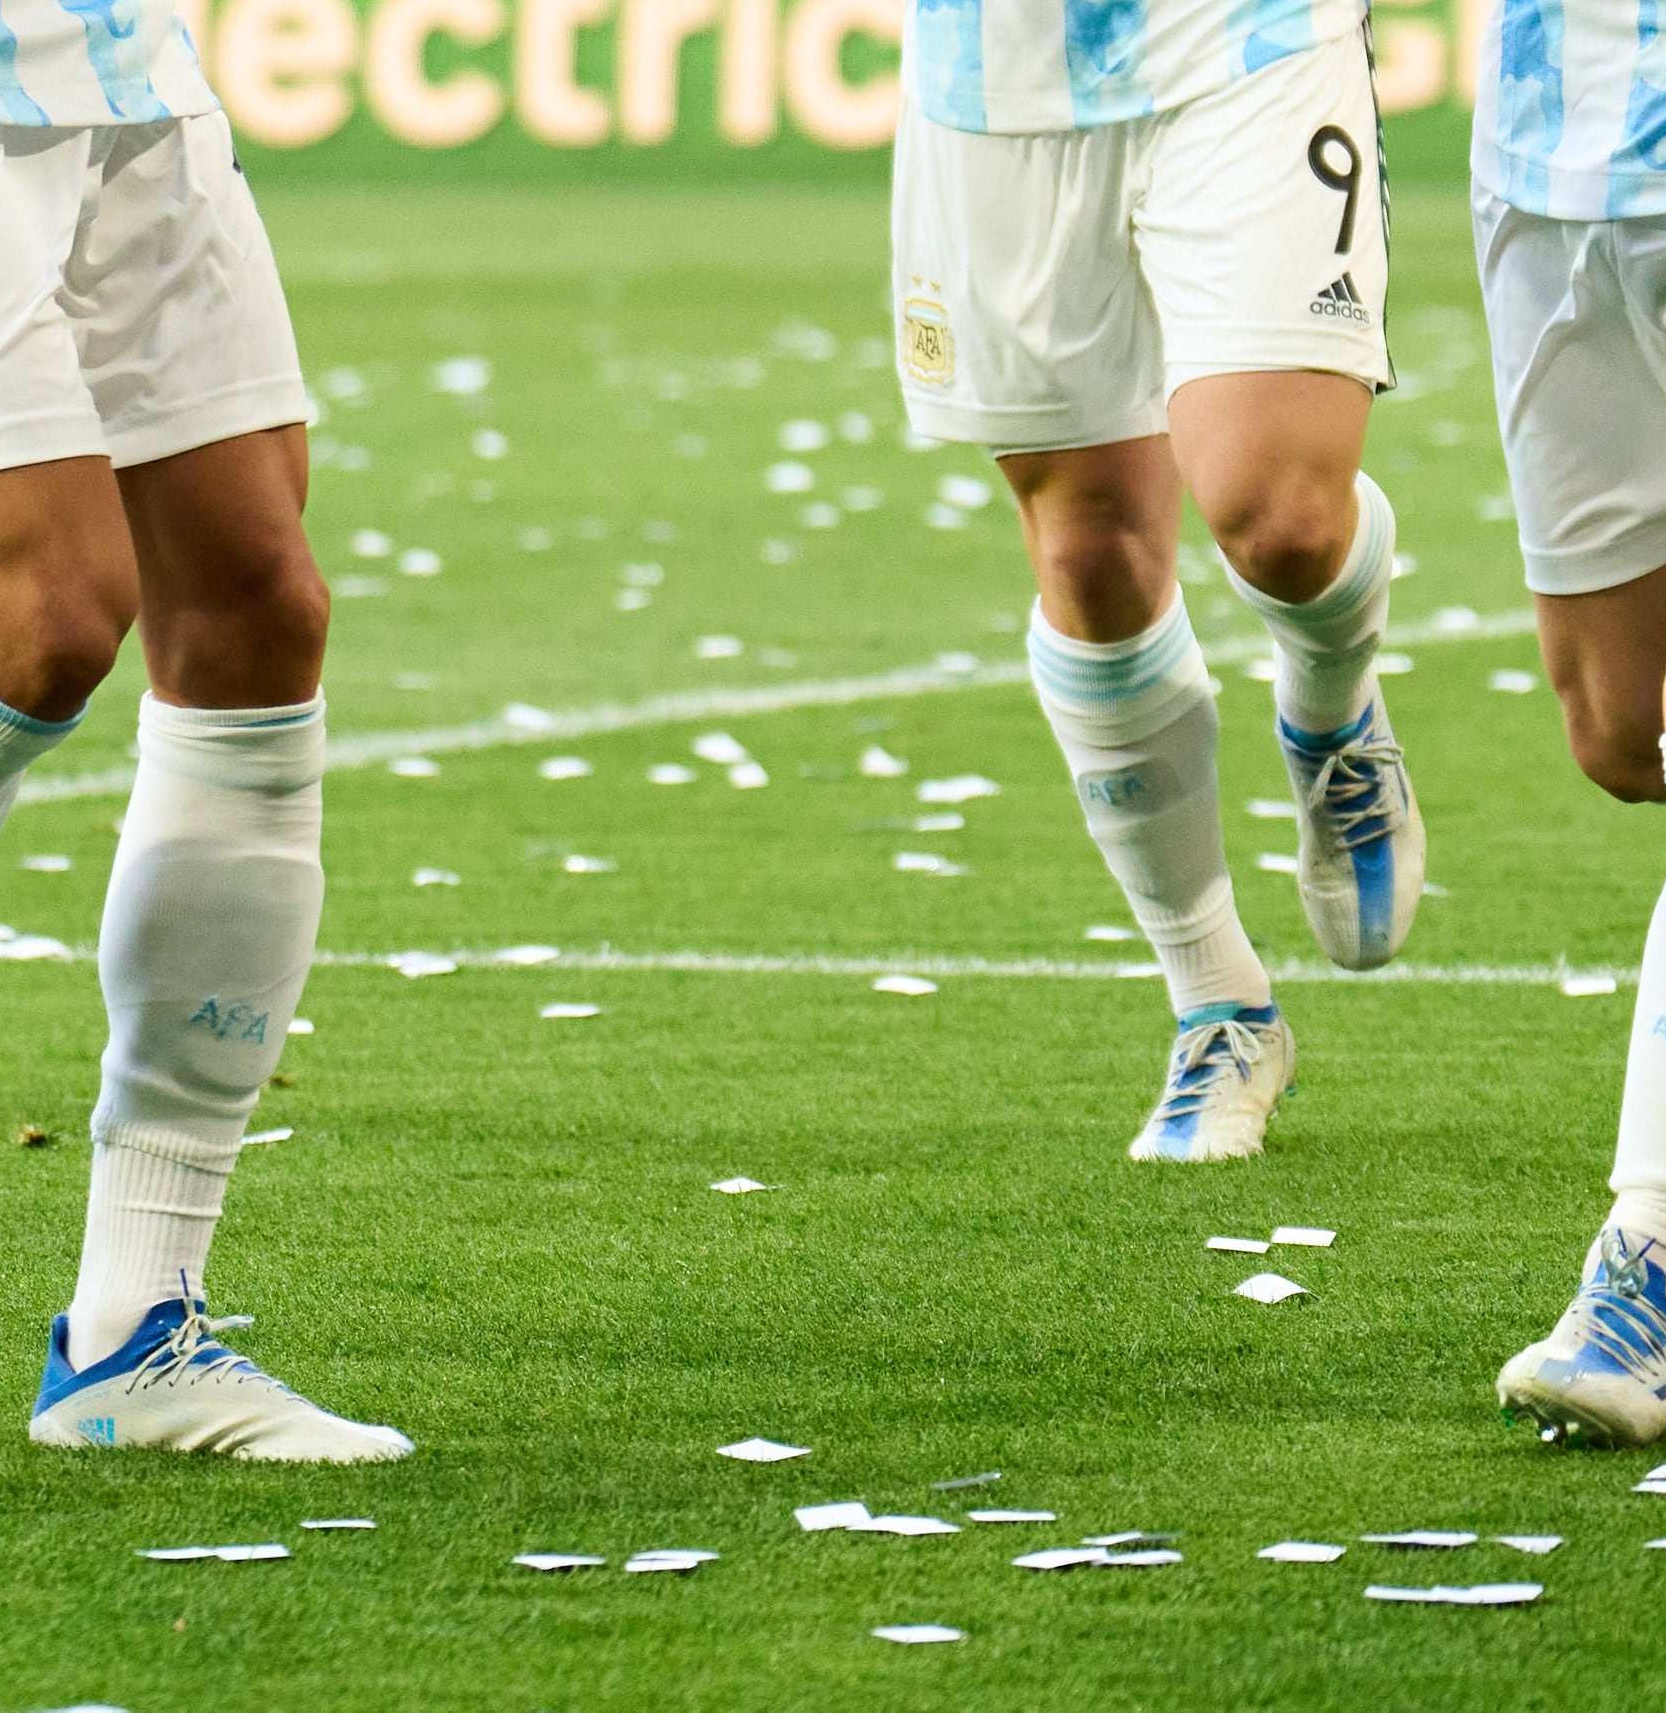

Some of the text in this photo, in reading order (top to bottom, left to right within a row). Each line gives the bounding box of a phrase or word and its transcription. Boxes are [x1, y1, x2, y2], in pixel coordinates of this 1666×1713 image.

[1308, 124, 1362, 254] 9
[1310, 297, 1370, 324] adidas
[916, 321, 942, 361] AFA
[190, 993, 271, 1044] AFA
